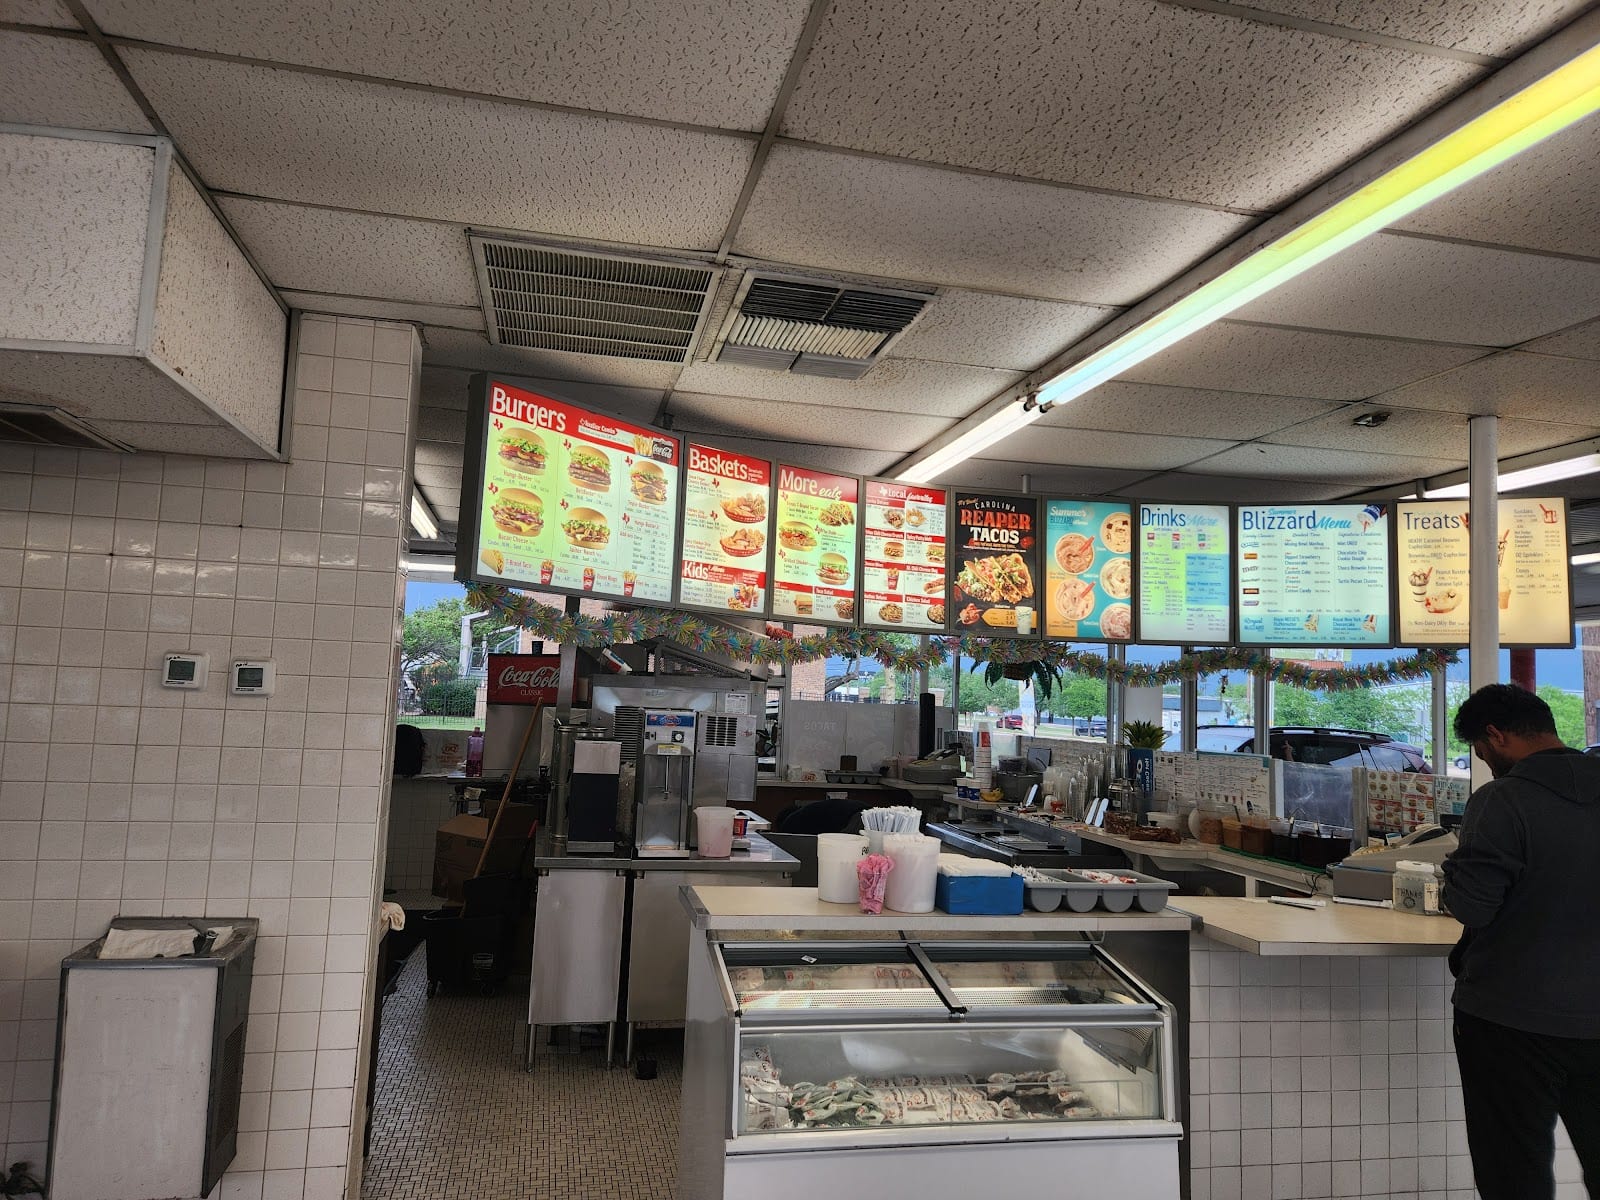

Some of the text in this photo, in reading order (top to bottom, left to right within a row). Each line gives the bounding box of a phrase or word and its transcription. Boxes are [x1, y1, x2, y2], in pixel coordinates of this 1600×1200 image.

[492, 386, 566, 432] Burgers
[689, 447, 748, 481] Baskets
[780, 469, 818, 494] More
[818, 486, 842, 502] eats
[888, 488, 906, 498] Local
[975, 500, 1016, 512] CAROLINA
[960, 508, 1032, 530] REAPER
[1142, 508, 1186, 526] Drinks
[1243, 510, 1352, 531] Blizzard Menu
[1403, 512, 1460, 530] Treats
[970, 526, 1020, 545] TACOS
